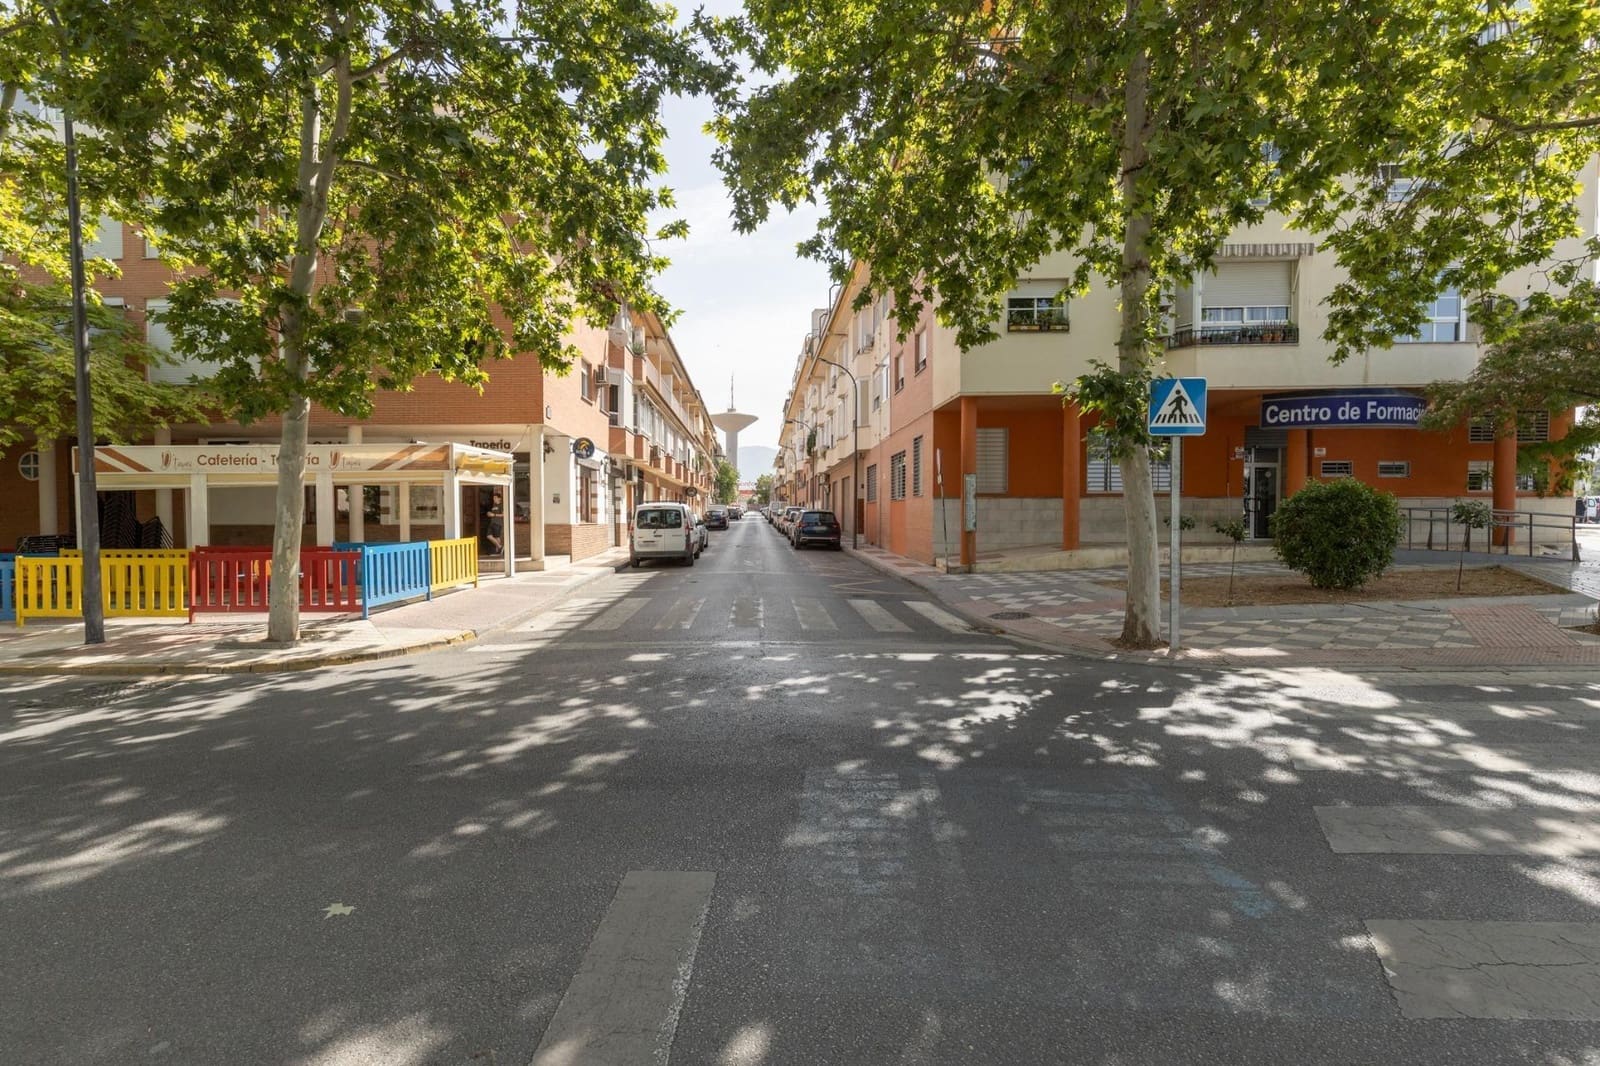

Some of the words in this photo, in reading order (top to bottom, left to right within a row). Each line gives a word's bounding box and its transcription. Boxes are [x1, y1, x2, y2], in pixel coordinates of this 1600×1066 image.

[1266, 405, 1331, 424] Centro
[1337, 401, 1361, 420] de
[197, 452, 258, 466] Cafetería
